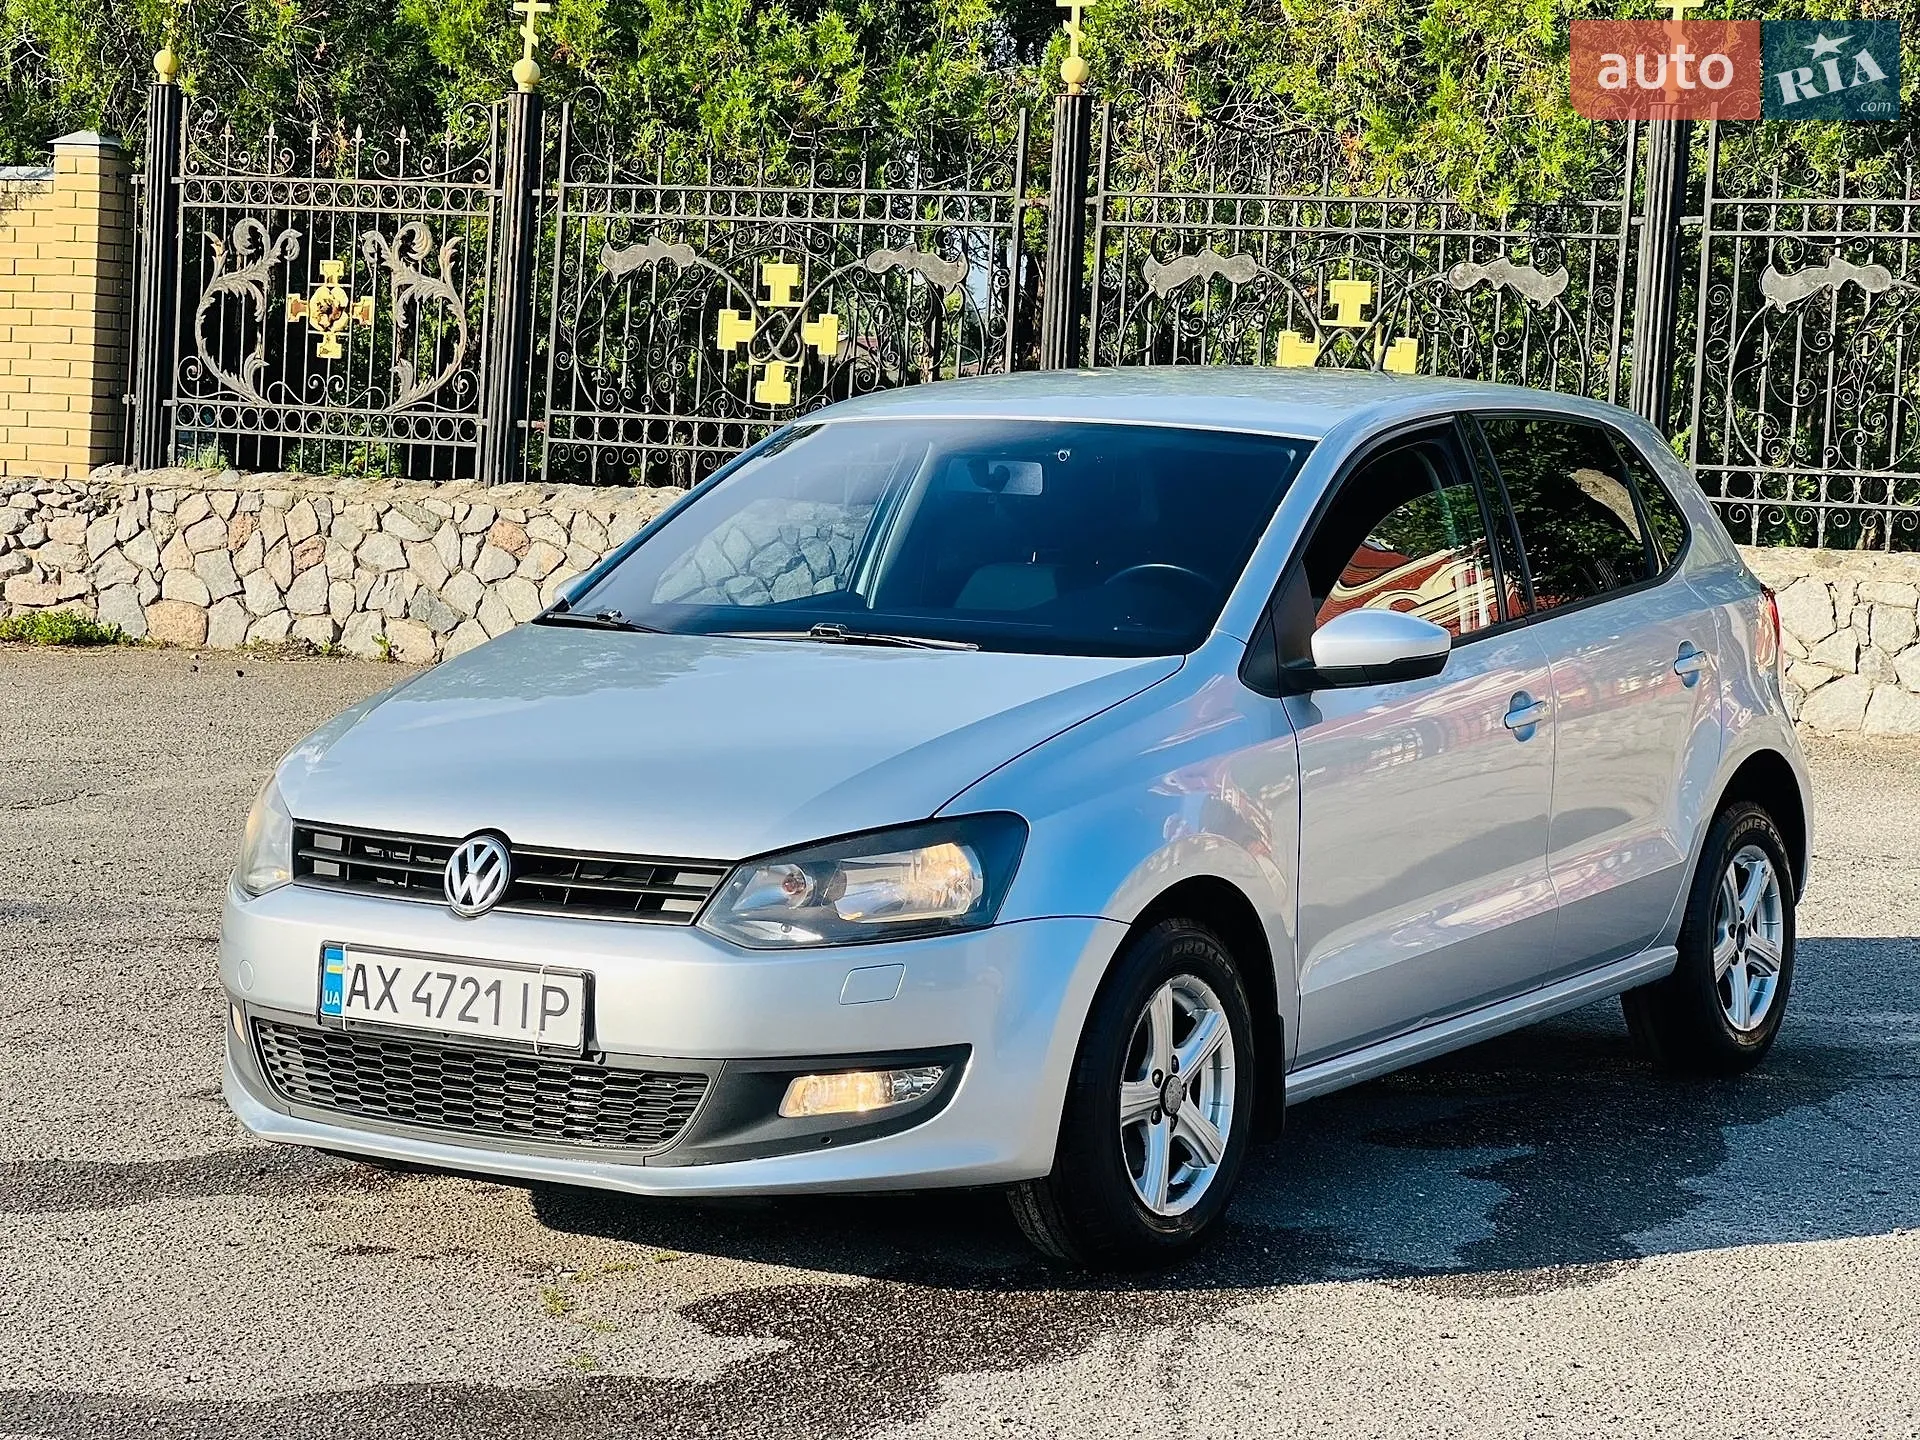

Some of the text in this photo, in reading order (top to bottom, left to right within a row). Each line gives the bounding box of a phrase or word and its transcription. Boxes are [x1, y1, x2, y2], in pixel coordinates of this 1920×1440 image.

[325, 990, 340, 1006] UA
[346, 963, 570, 1032] AX 4721 IP
